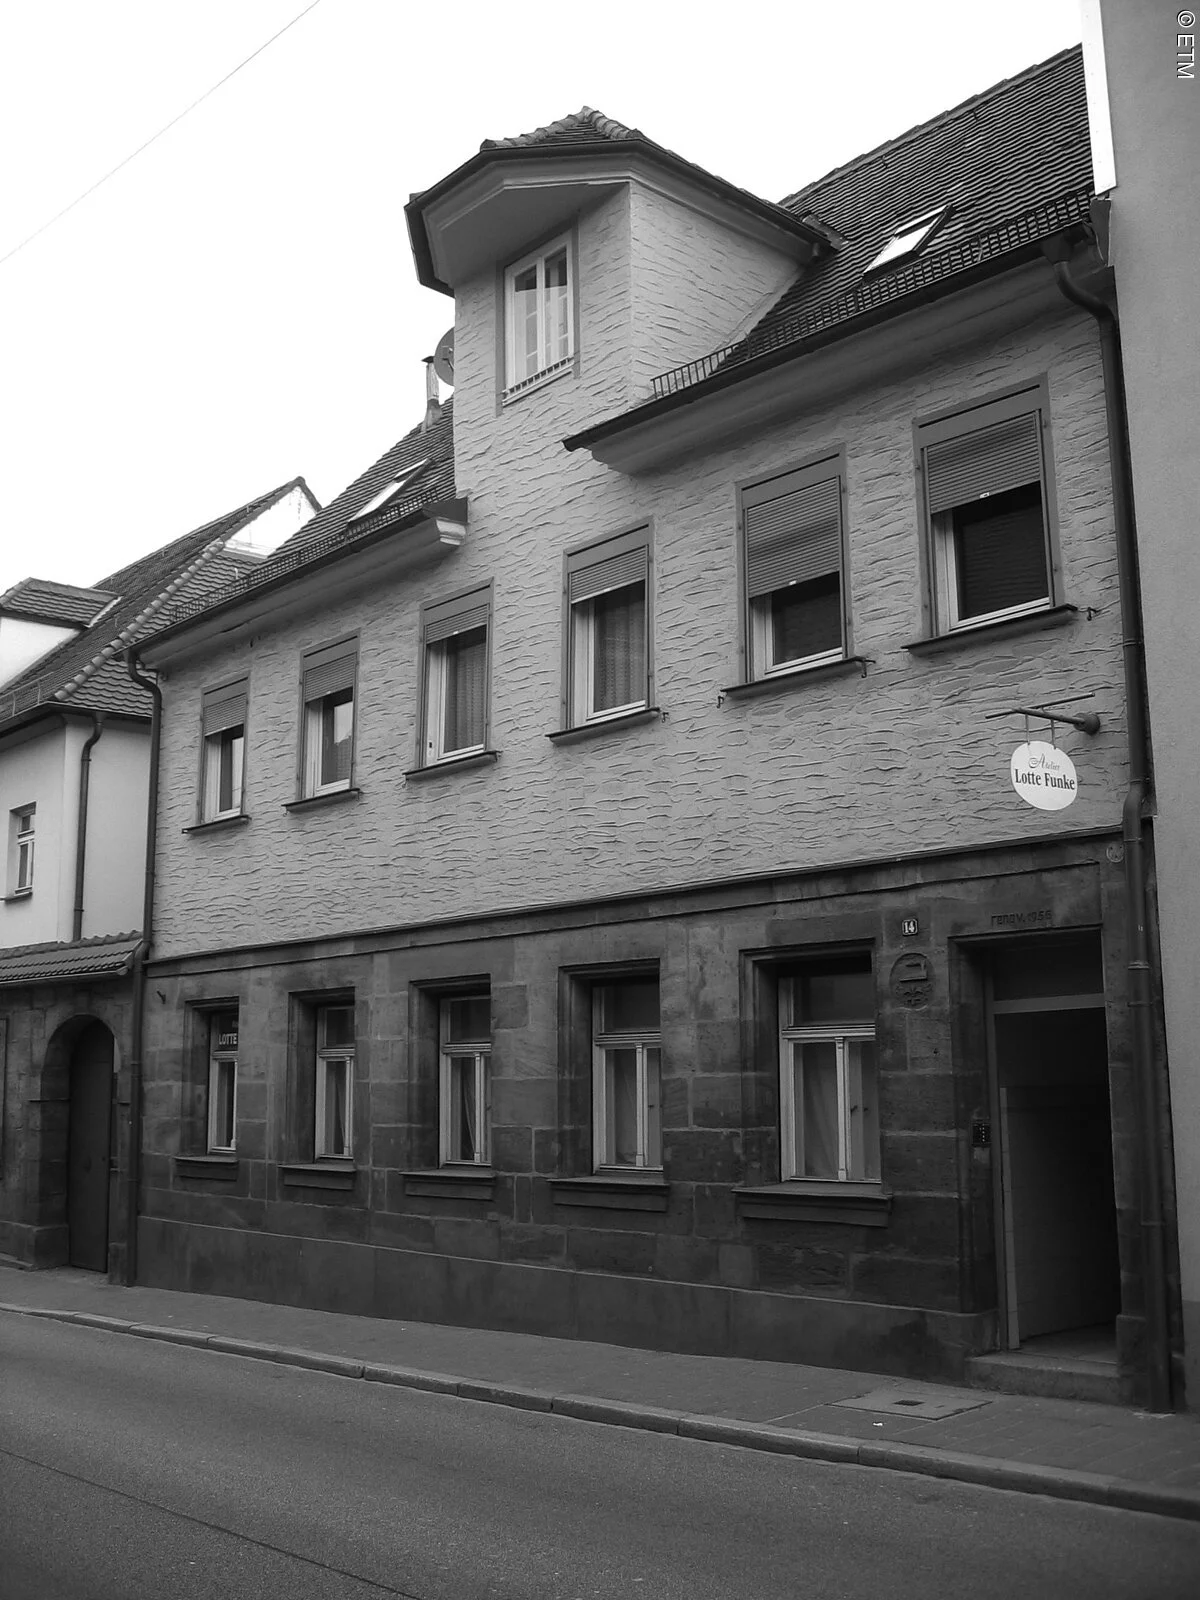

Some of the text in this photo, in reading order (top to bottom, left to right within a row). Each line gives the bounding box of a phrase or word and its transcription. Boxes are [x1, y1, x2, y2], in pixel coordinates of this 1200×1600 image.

[1015, 769, 1075, 790] Lotte Funke
[904, 920, 915, 933] 14
[219, 1033, 237, 1045] LOTTE
